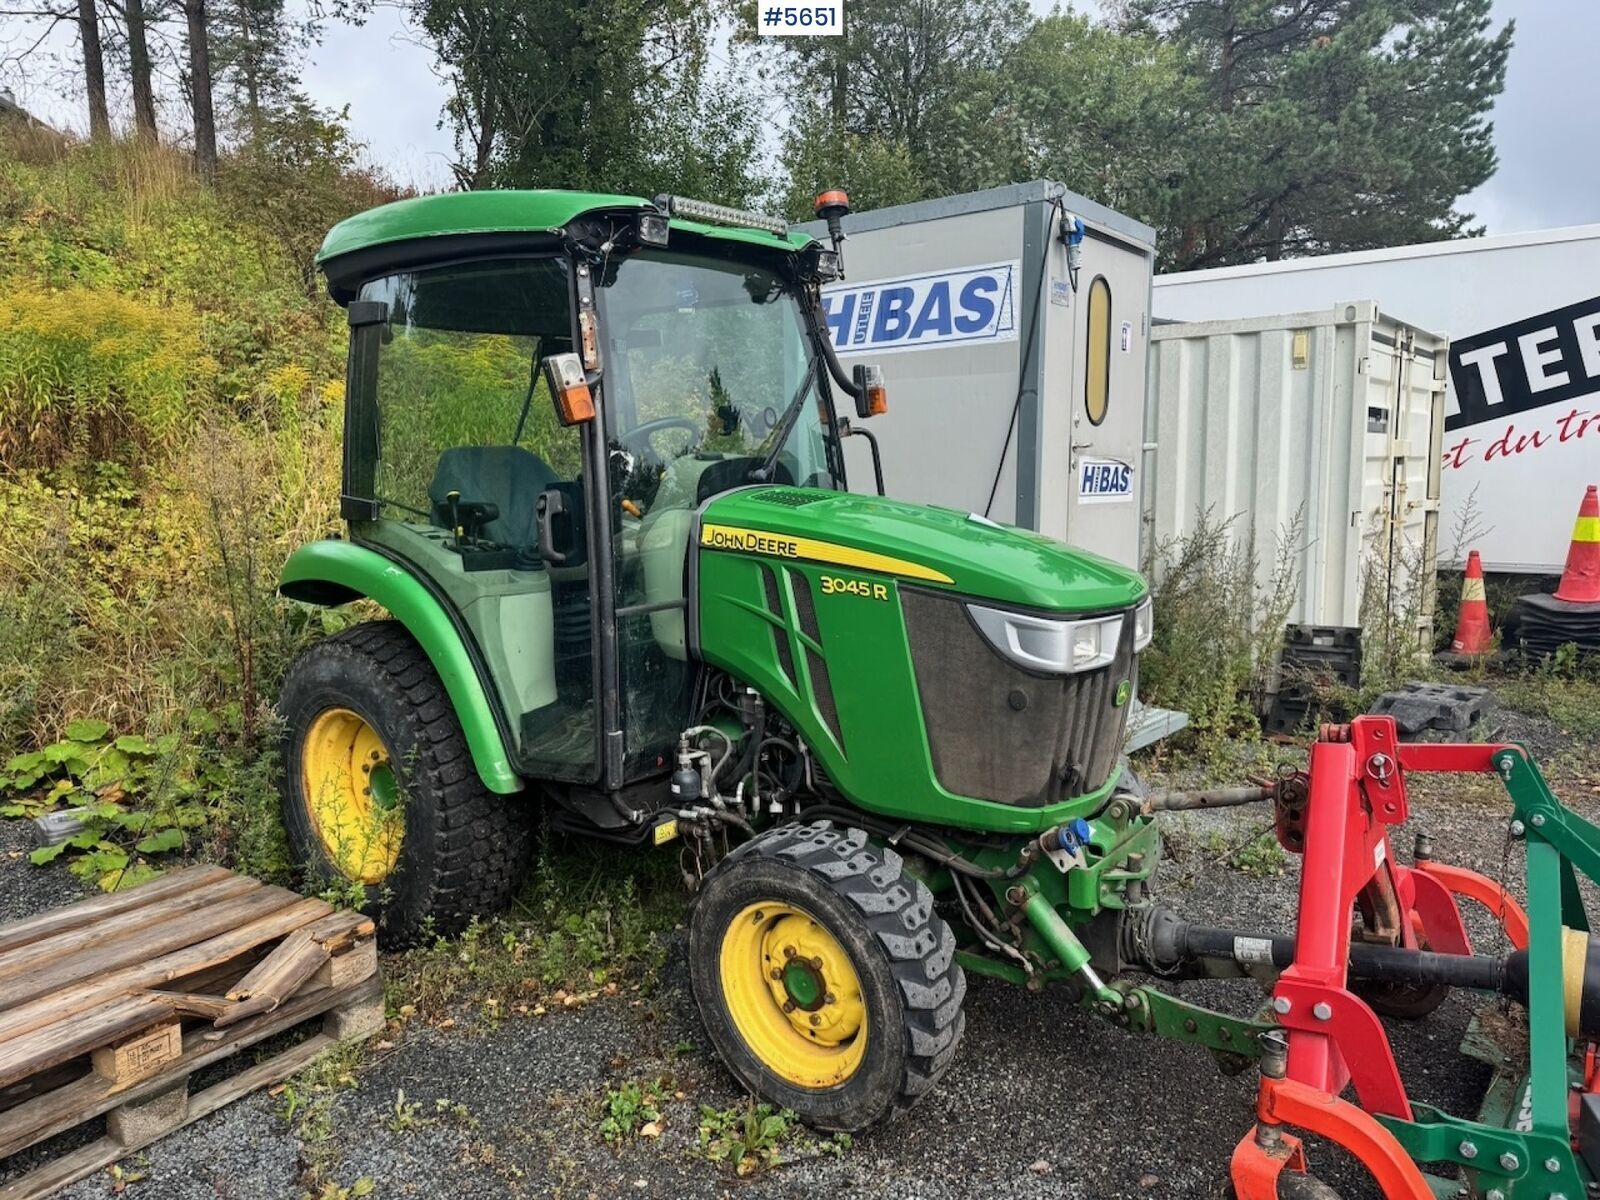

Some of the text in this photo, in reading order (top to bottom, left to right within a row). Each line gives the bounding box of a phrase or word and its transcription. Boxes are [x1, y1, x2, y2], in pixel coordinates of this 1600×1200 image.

[854, 292, 874, 343] UTLEIE
[1485, 425, 1552, 461] du
[1556, 409, 1600, 442] tr
[707, 529, 797, 556] JOHN DEERE
[820, 576, 889, 601] 3045 R
